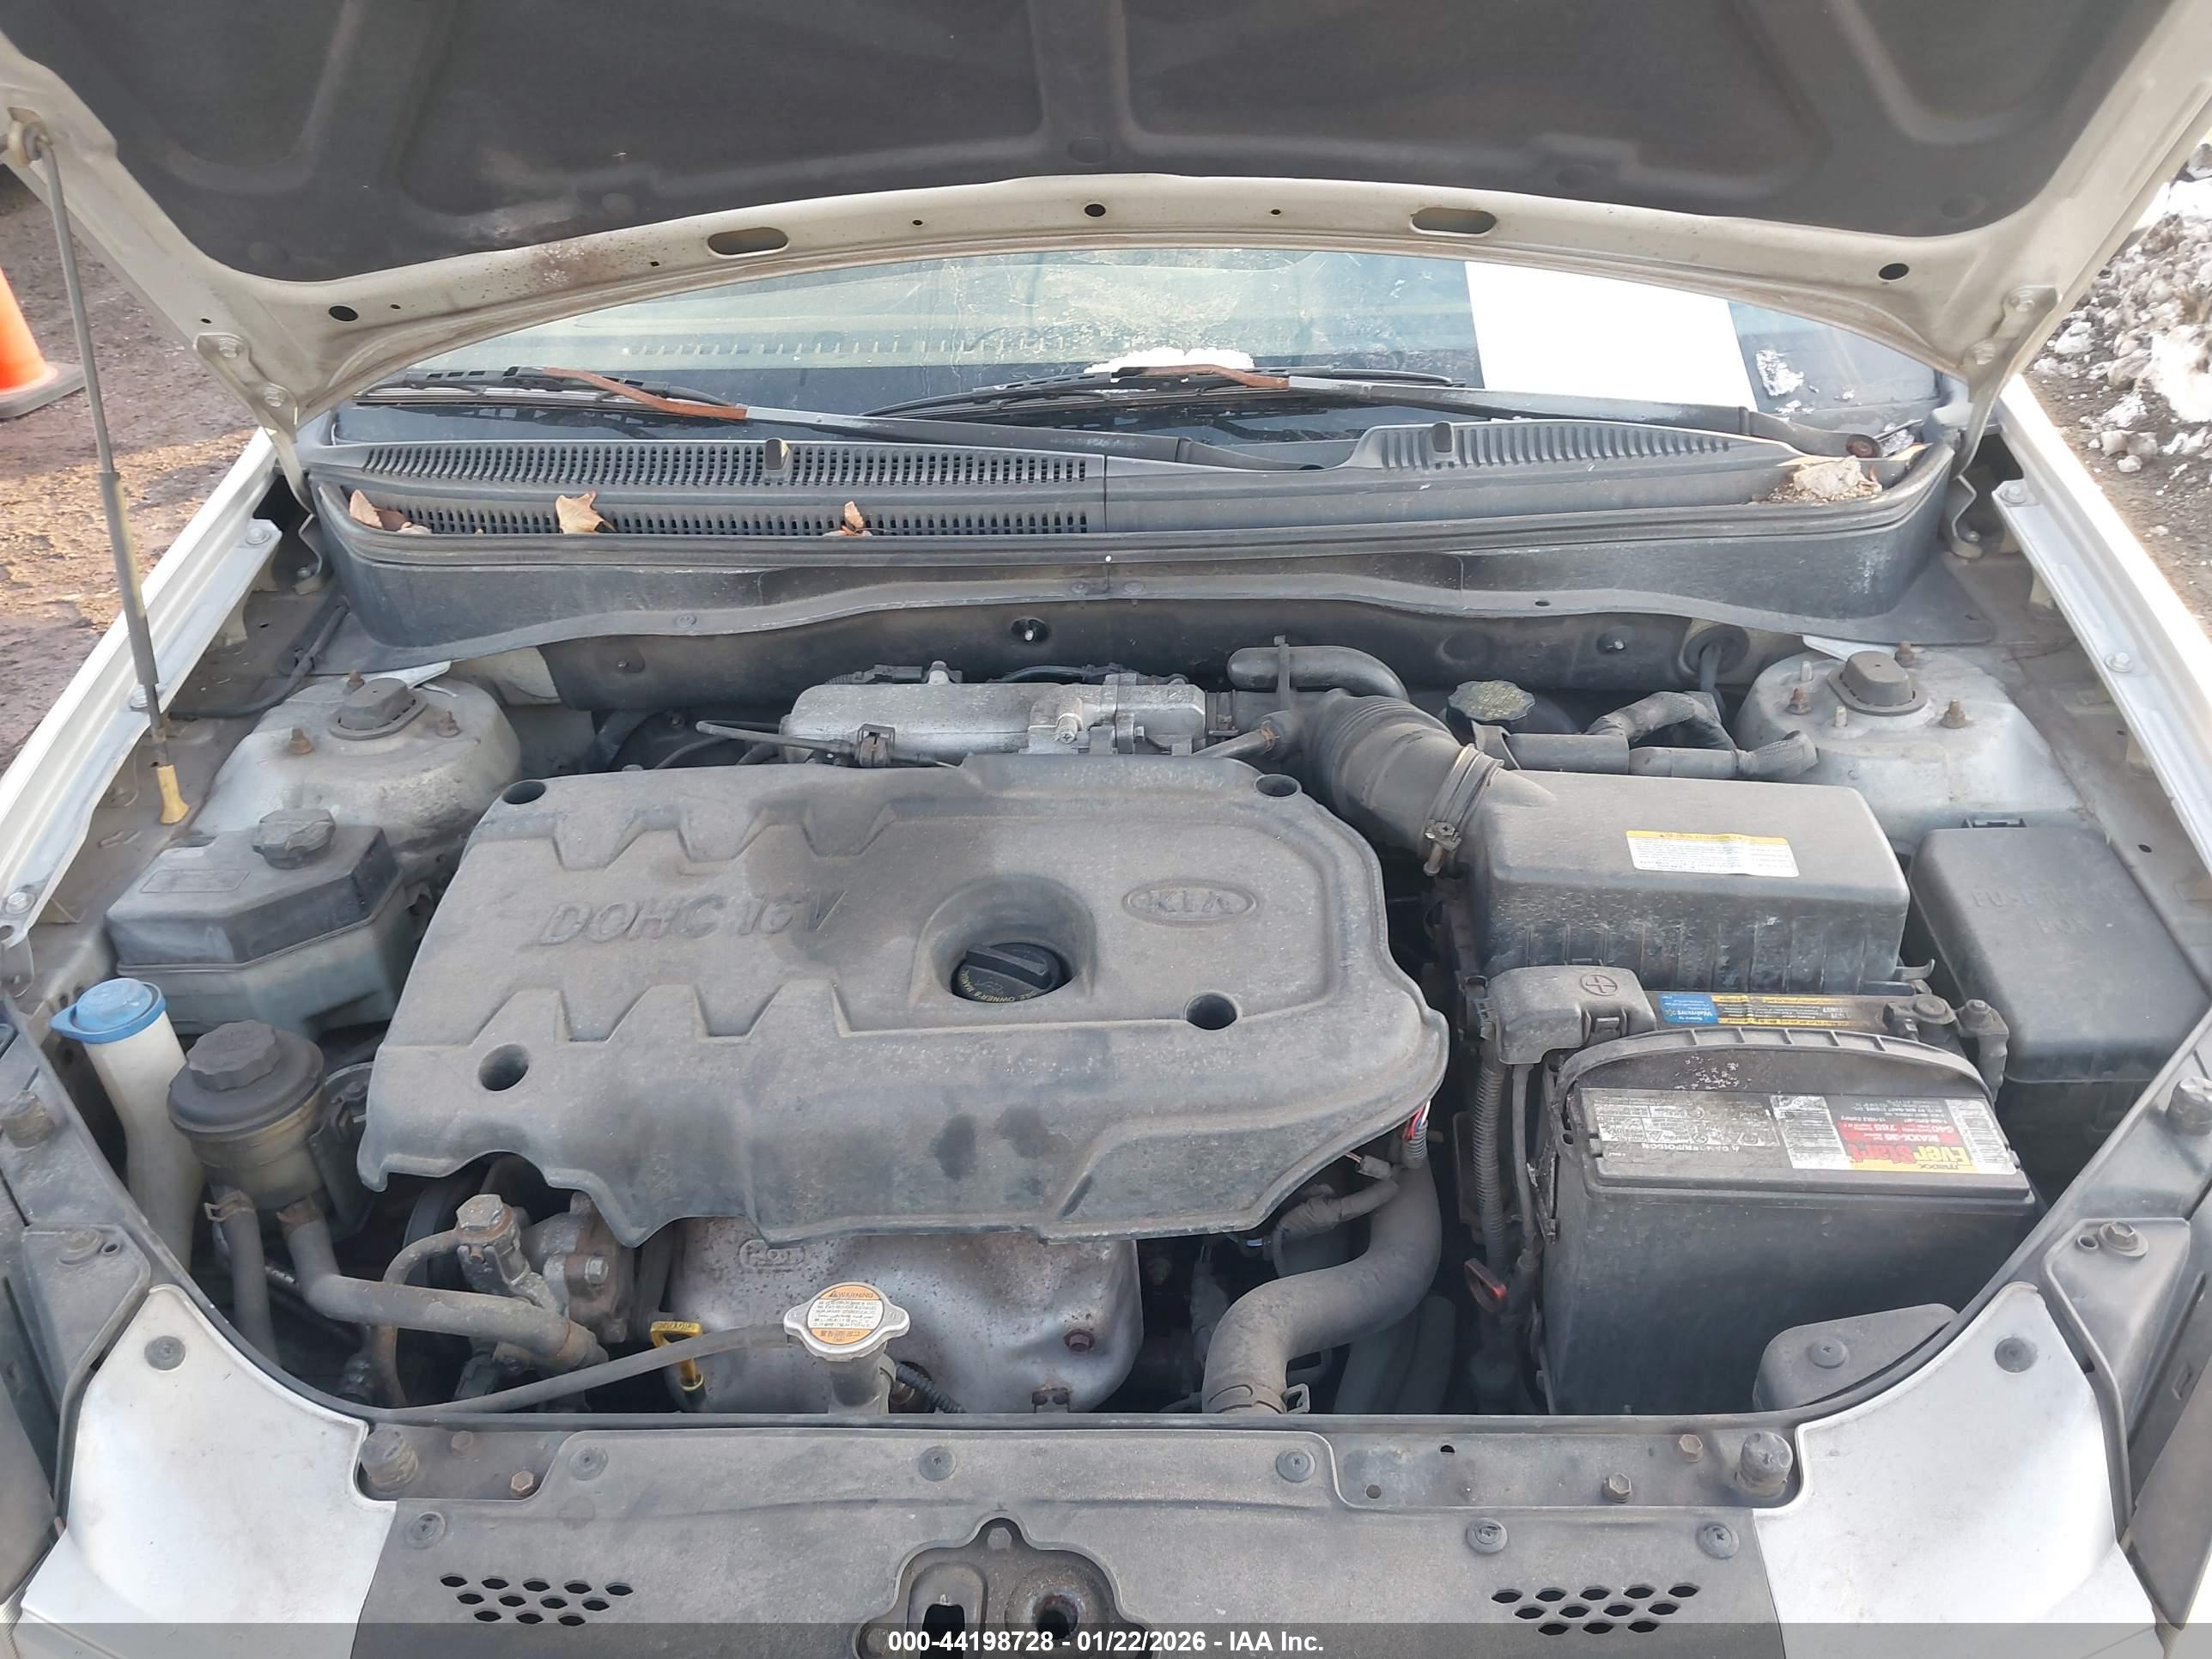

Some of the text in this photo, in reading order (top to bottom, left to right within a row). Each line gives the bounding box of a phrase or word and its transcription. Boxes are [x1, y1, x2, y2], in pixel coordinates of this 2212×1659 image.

[1146, 890, 1235, 915] KIA
[539, 889, 847, 945] DOHC 16V
[961, 969, 975, 994] MANUAL
[974, 991, 1015, 1003] OWNER'S
[1846, 1143, 1972, 1166] EverStart
